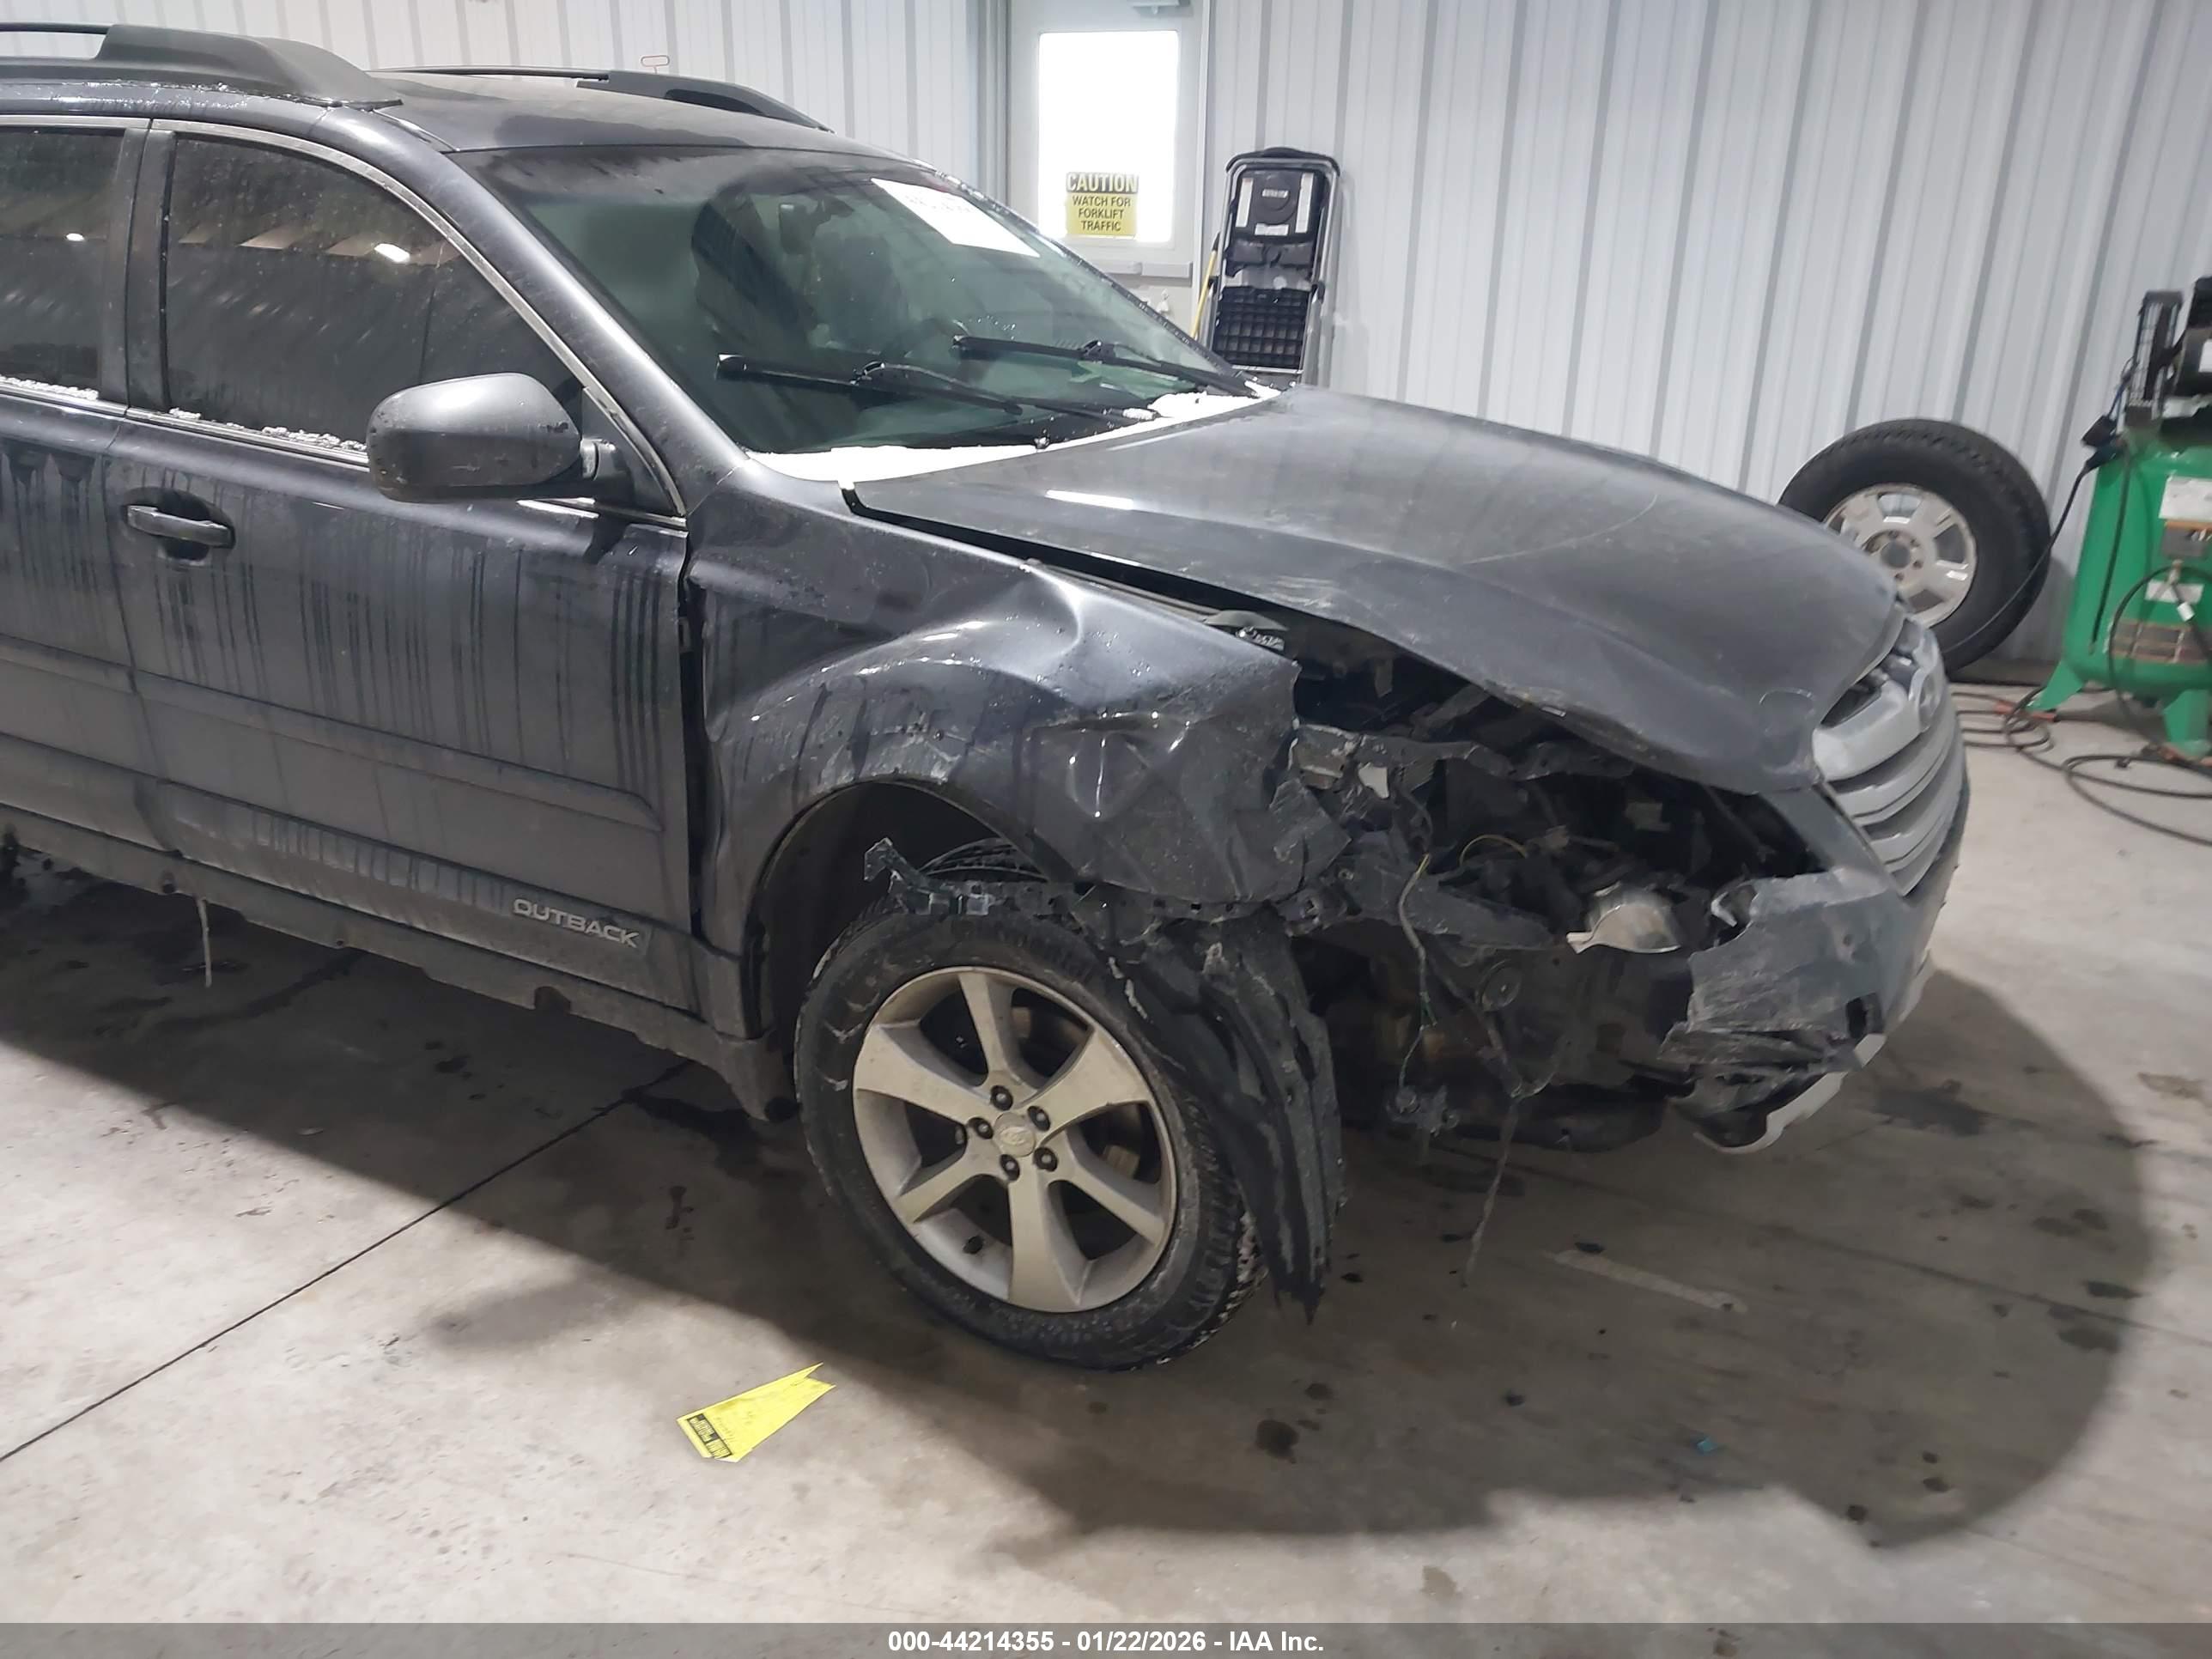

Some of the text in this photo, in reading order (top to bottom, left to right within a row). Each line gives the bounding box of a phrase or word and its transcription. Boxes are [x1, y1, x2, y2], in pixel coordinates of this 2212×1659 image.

[1066, 173, 1138, 192] CAUTION
[1073, 196, 1131, 207] WATCH FOR
[1078, 208, 1124, 219] FORKLIFT
[1081, 220, 1121, 231] TRAFFIC
[513, 898, 640, 948] OUTBACK
